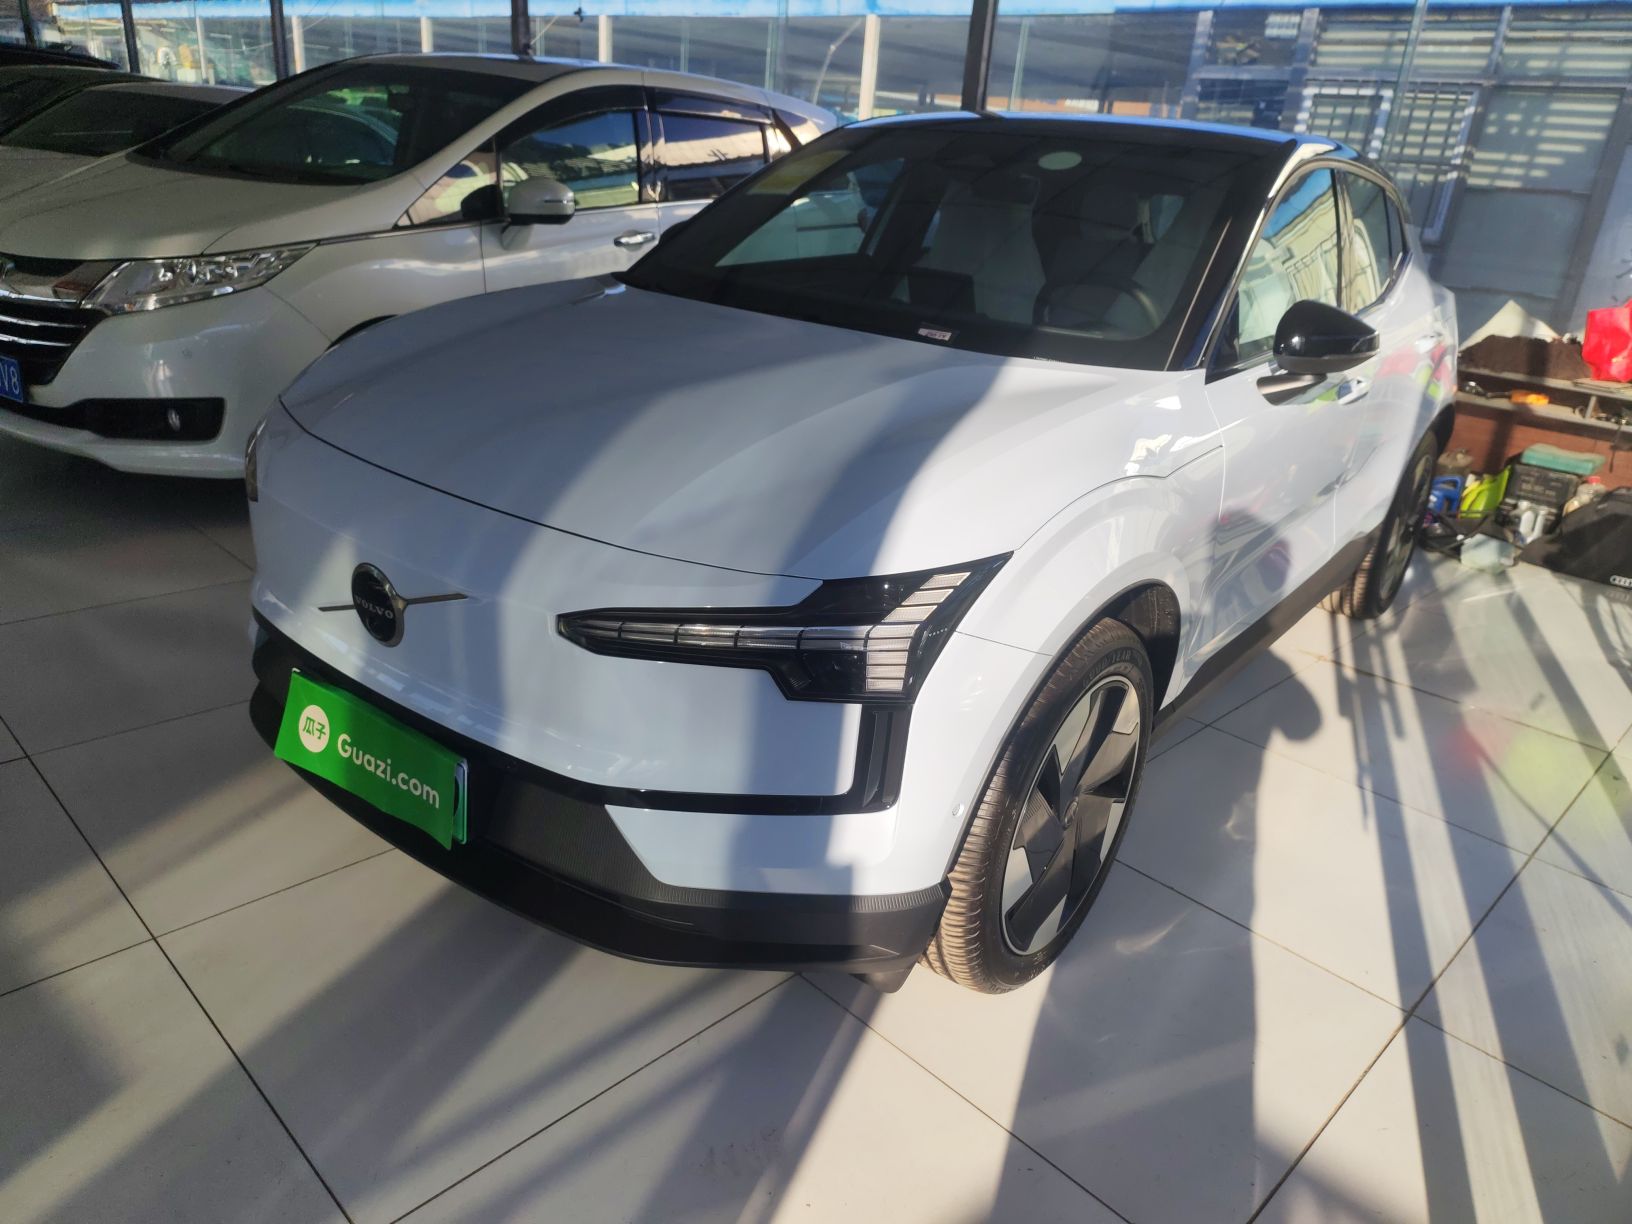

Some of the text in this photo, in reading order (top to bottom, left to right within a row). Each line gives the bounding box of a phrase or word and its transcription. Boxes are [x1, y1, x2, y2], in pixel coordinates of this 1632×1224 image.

[354, 595, 394, 620] VOLVO
[302, 716, 327, 740] 瓜子
[337, 732, 440, 809] Guazi.com
